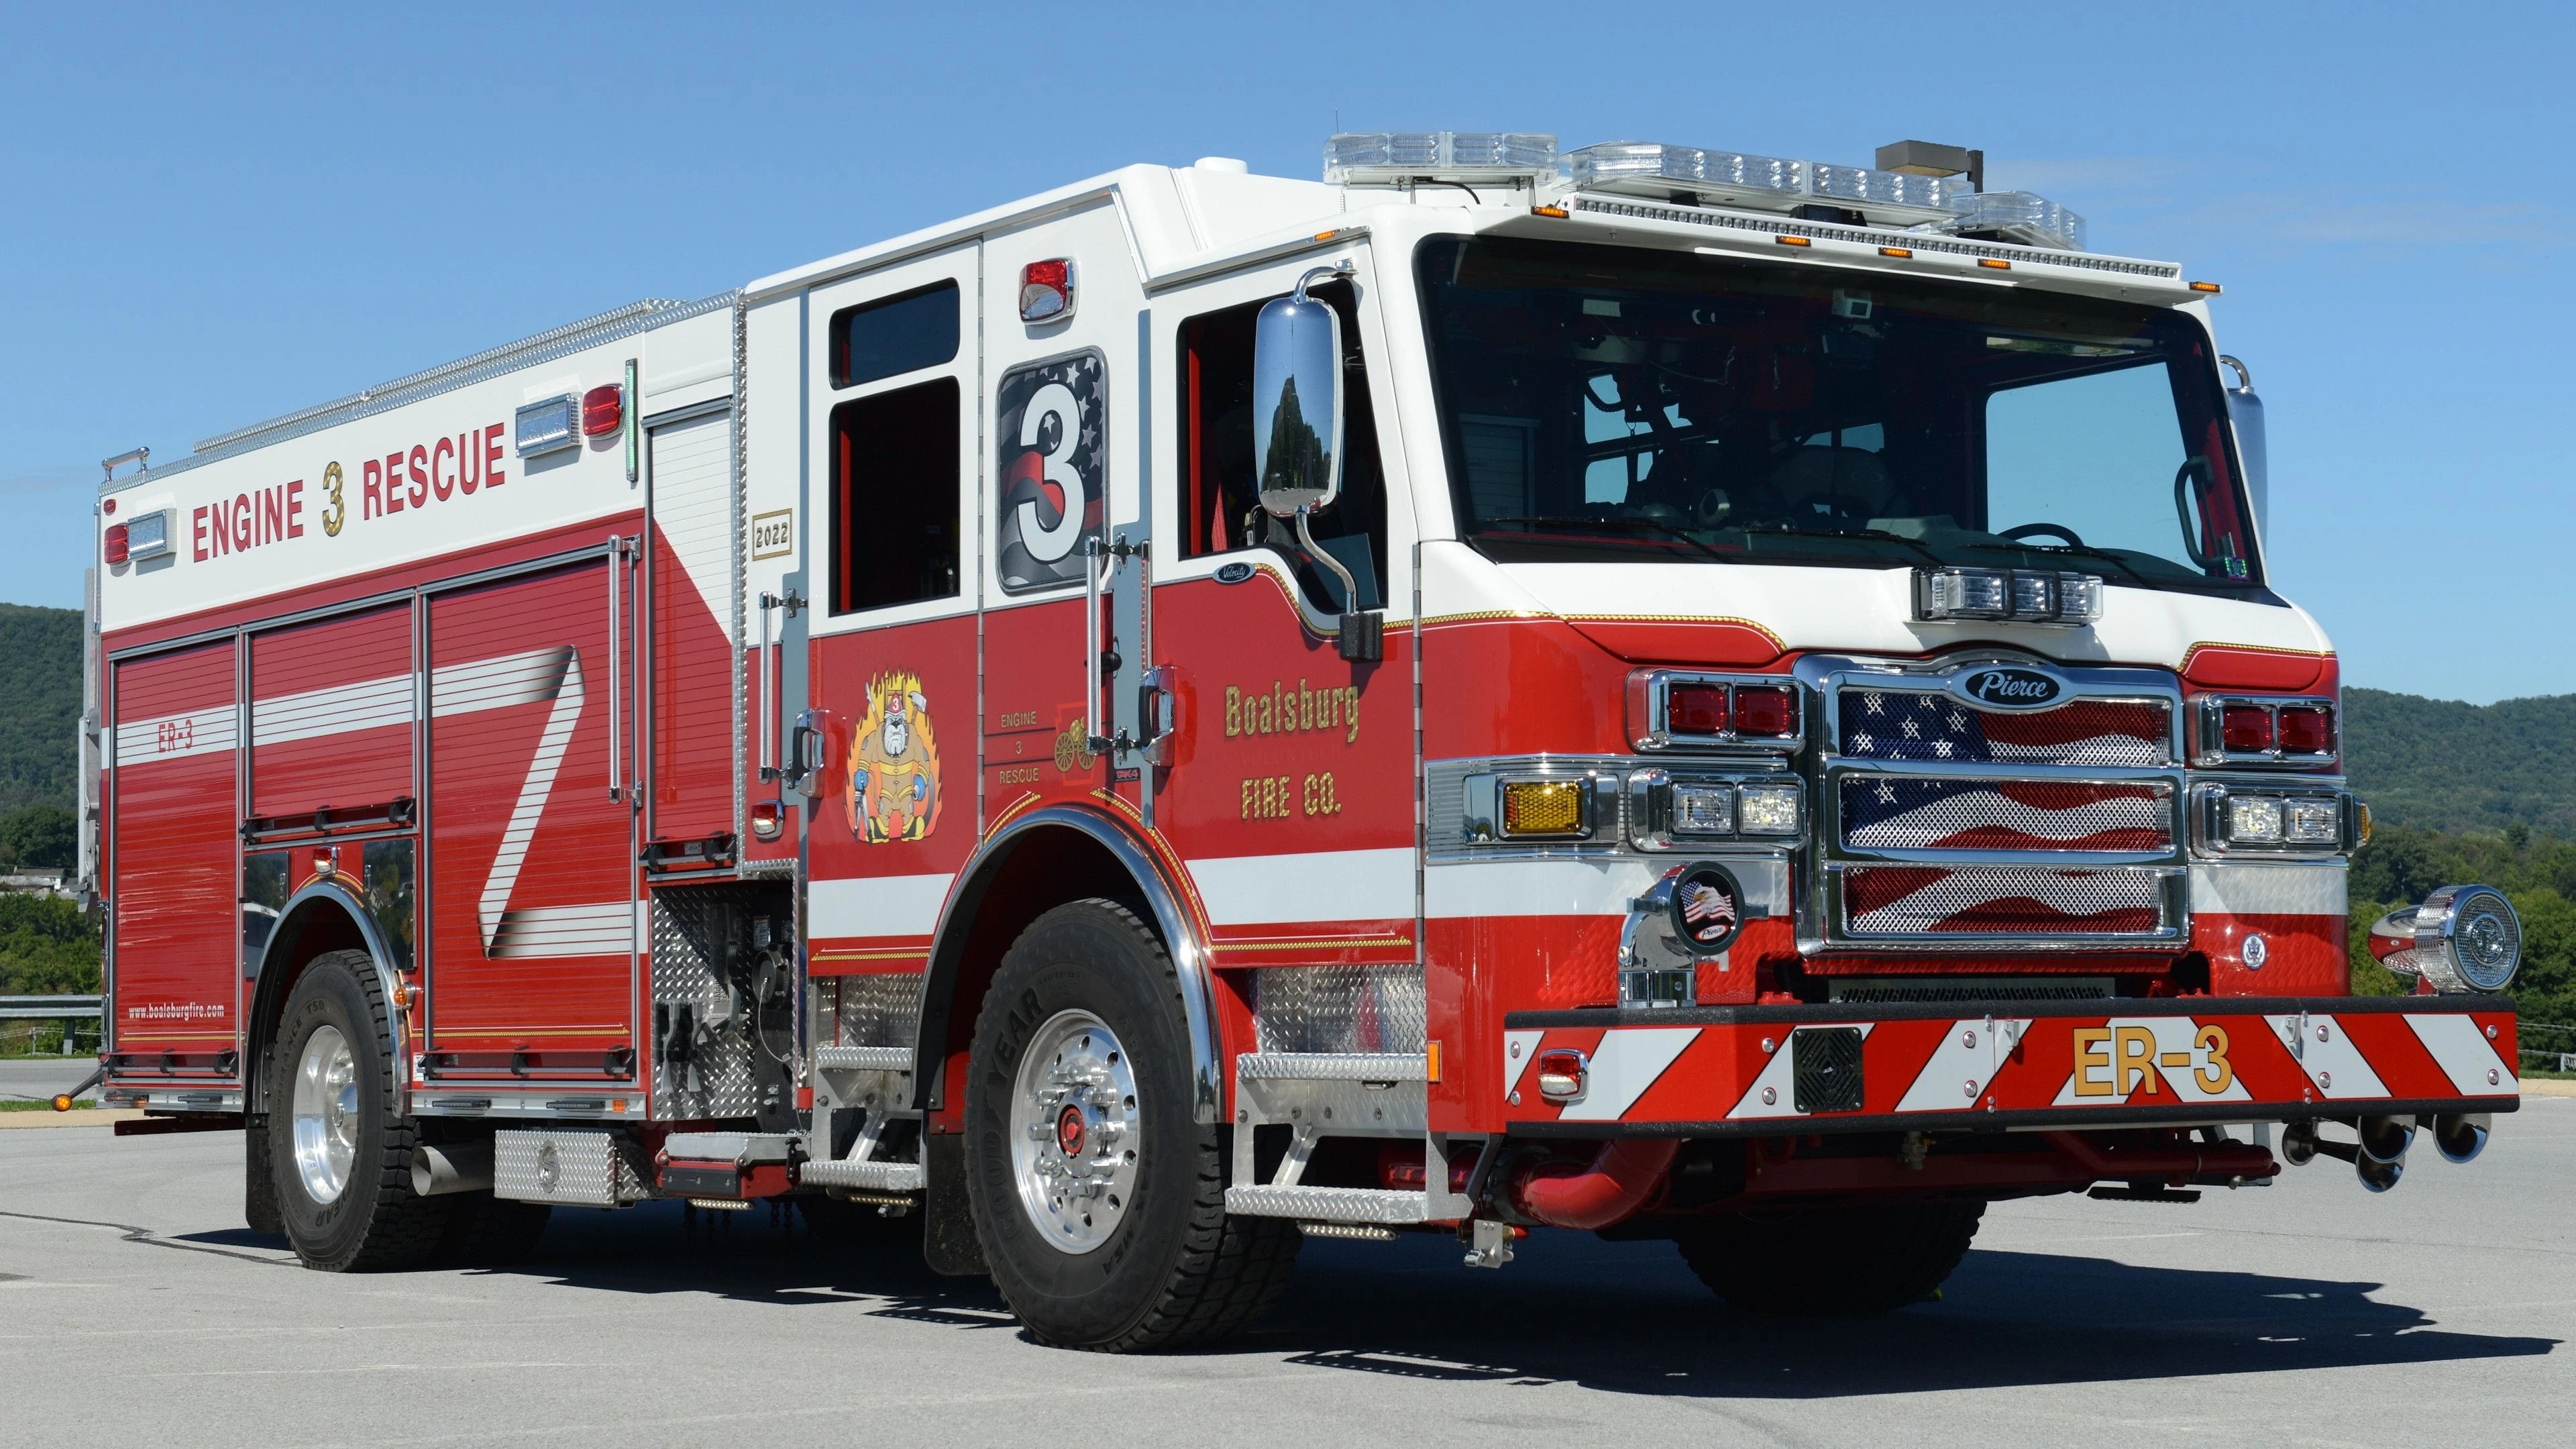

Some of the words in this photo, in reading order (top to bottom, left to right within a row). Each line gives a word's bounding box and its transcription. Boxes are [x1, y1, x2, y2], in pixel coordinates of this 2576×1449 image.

[1016, 380, 1087, 564] 3
[193, 479, 303, 563] ENGINE
[322, 461, 345, 537] 3
[364, 422, 506, 520] RESCUE
[756, 522, 788, 548] 2022
[1223, 565, 1246, 579] Velocity
[1979, 672, 2048, 700] Pierce
[892, 698, 900, 711] 3
[1226, 677, 1358, 743] Boalsburg
[1001, 711, 1037, 728] ENGINE
[158, 719, 193, 753] ER-3
[1016, 741, 1023, 755] 3
[1000, 767, 1039, 784] RESCUE
[1242, 775, 1291, 820] FIRE
[1304, 771, 1342, 816] CO.
[1702, 927, 1723, 938] Pierce
[129, 1002, 225, 1021] www.boalsburgfire.com
[2074, 1024, 2233, 1096] ER-3
